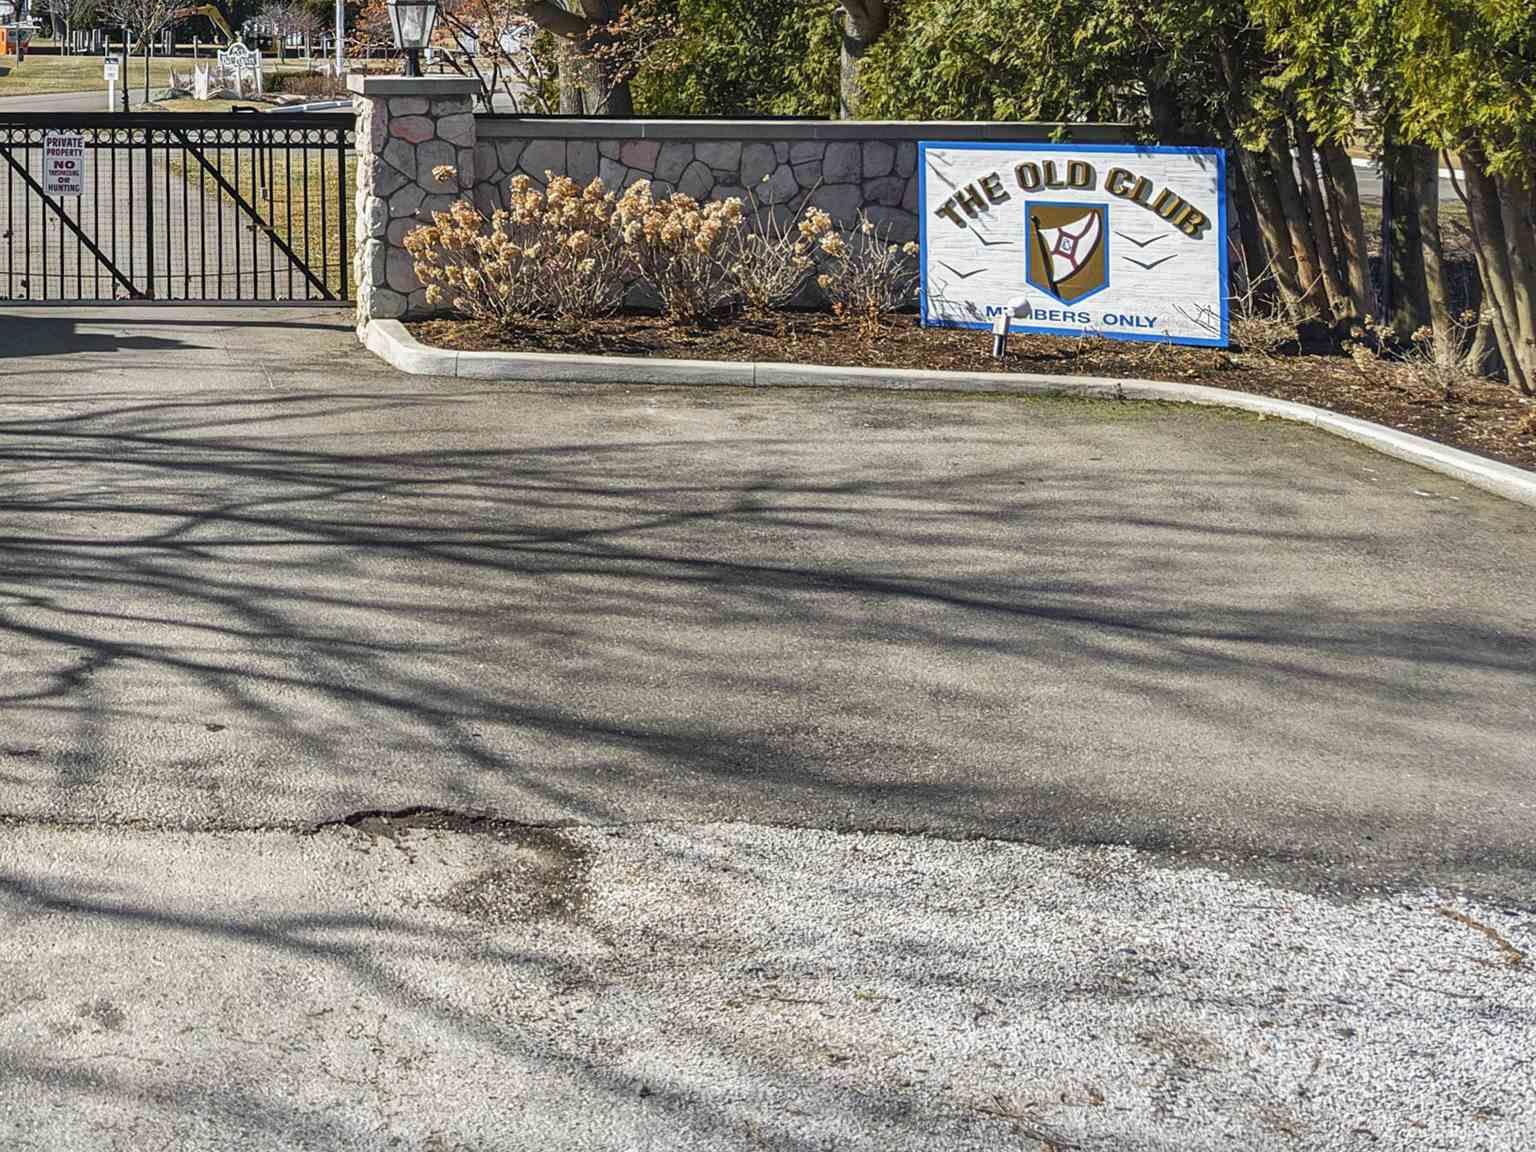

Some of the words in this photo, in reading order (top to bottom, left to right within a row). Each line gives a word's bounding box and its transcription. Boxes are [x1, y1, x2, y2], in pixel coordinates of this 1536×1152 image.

[46, 137, 83, 147] PRIVATE
[46, 148, 83, 156] PROPERTY
[54, 160, 75, 169] NO
[48, 184, 80, 192] HUNTING
[933, 170, 1012, 230] THE
[1013, 158, 1097, 193] OLD
[1103, 165, 1213, 241] CLUB
[985, 305, 1091, 324] MBERS
[1102, 313, 1158, 328] ONLY
